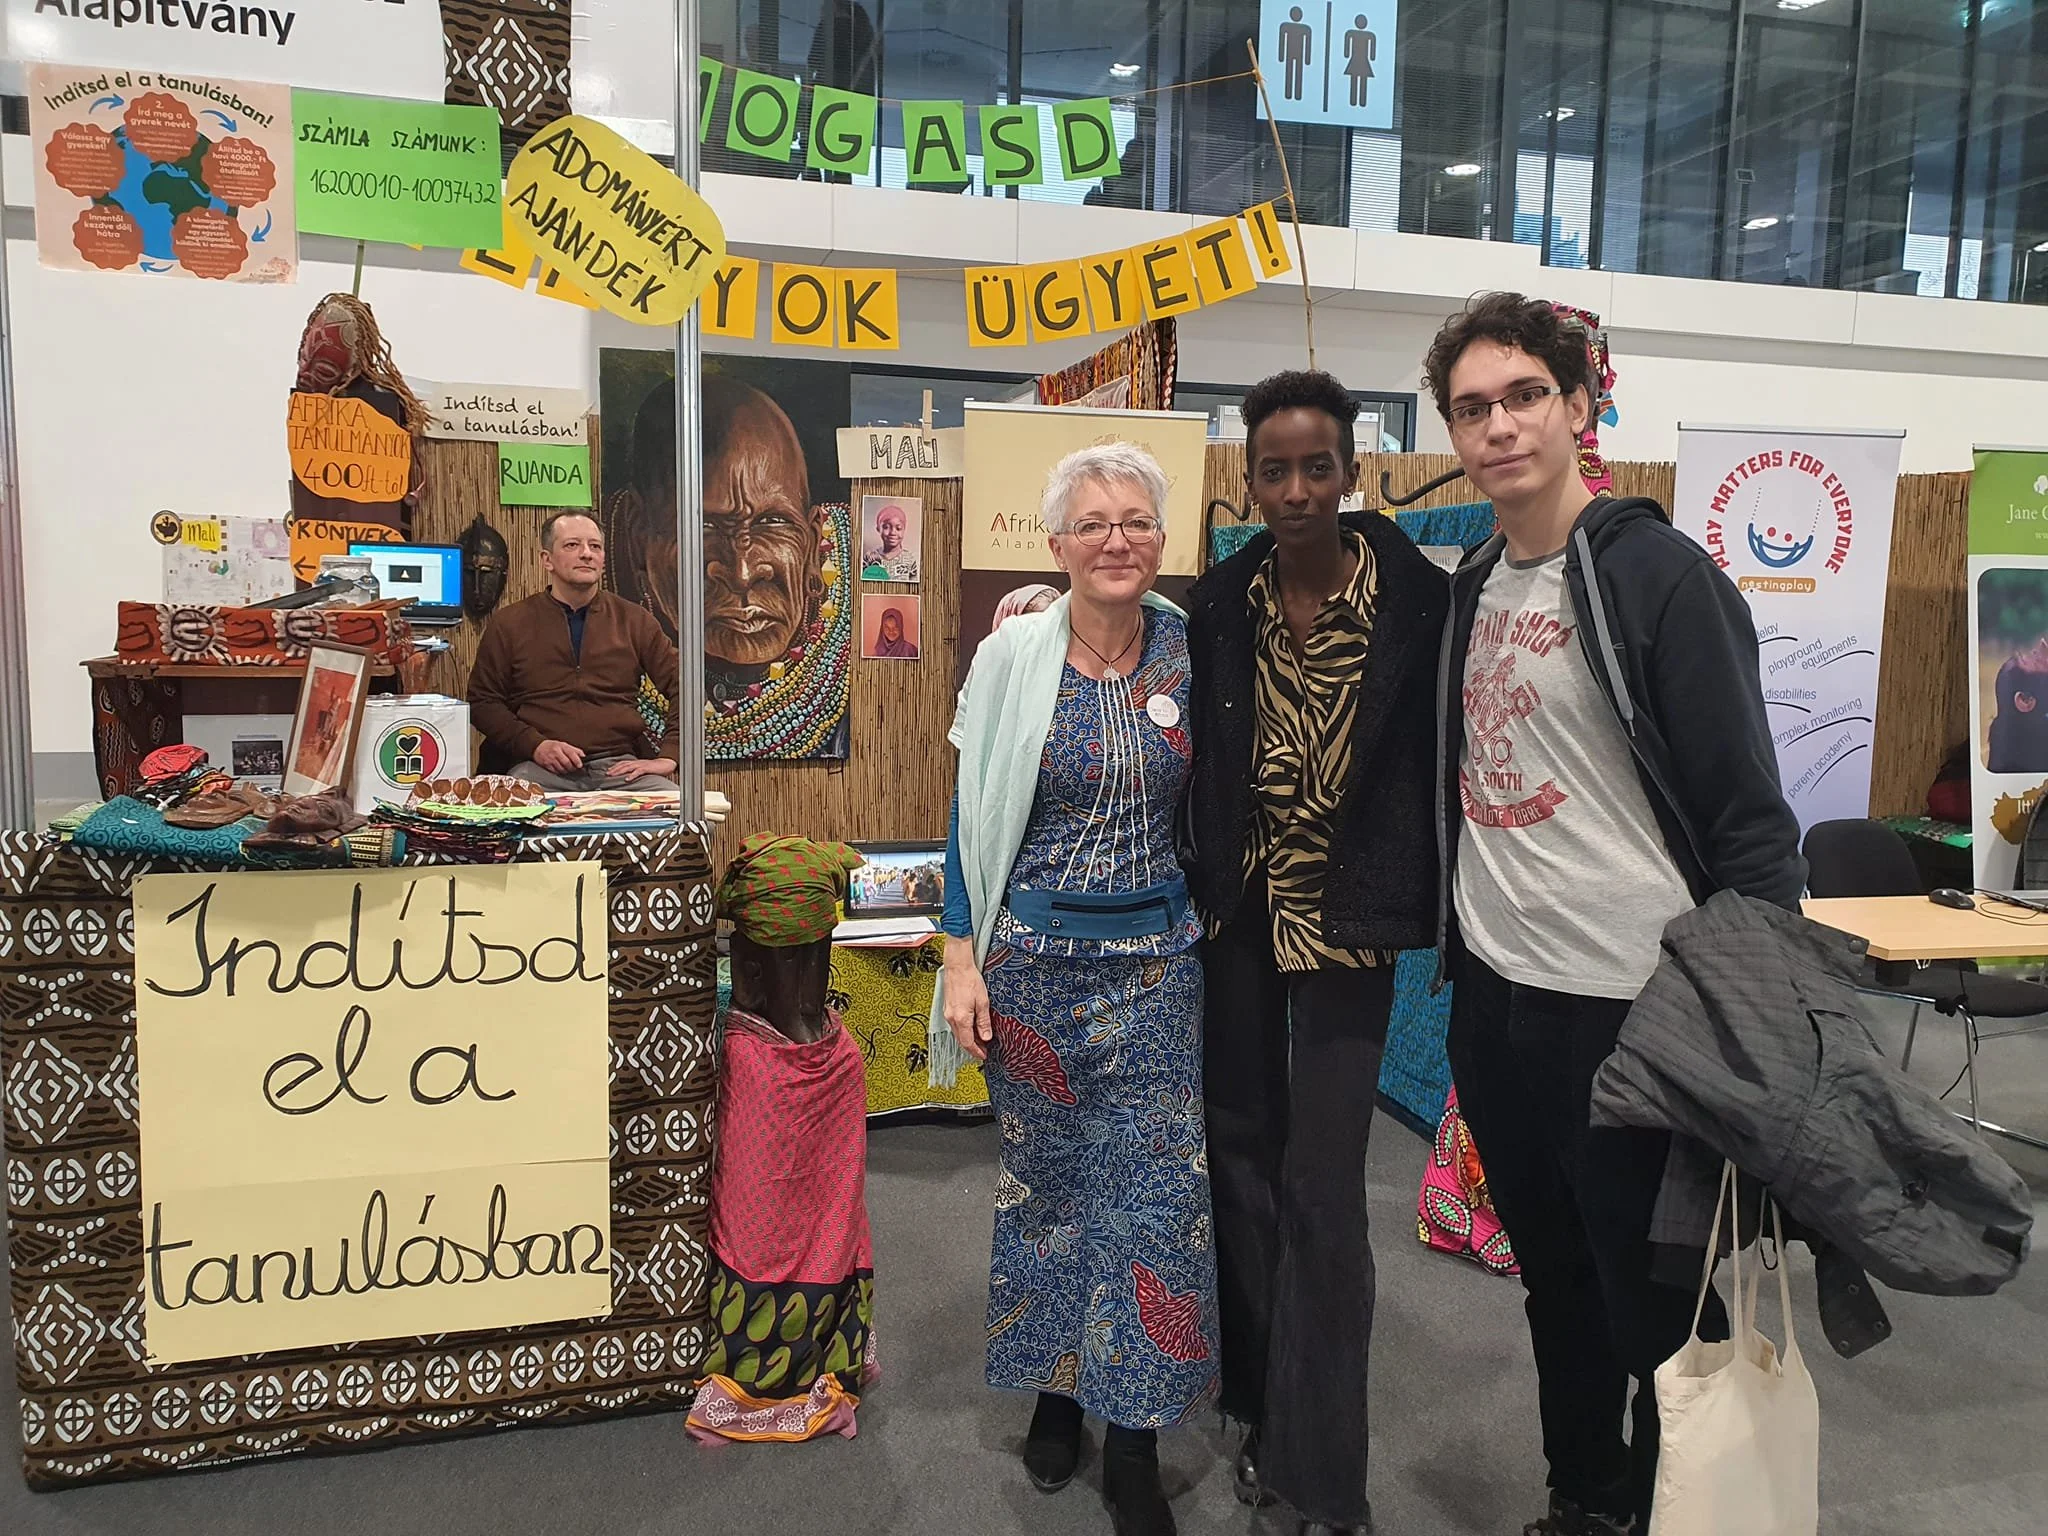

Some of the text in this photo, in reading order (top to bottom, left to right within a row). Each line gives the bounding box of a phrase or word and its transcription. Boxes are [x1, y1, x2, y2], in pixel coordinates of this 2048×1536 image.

[44, 71, 274, 128] Indítsd el a tanulásban!
[138, 105, 151, 117] Írd
[153, 110, 174, 120] meg
[130, 117, 191, 129] gyerek nevét
[299, 117, 487, 153] SZÁMLA SZÁMUNK:
[310, 169, 497, 204] 16200010-10097432
[529, 128, 713, 271] ADOMÁNYÉRT
[509, 182, 666, 314] AJÁNDÉK
[974, 210, 1280, 340] ÜGYÉT!
[289, 393, 369, 429] AFRIKA
[444, 396, 544, 415] Indítsd el
[443, 417, 579, 438] a tanulásban!
[870, 433, 940, 470] MALI
[501, 457, 583, 487] RUANDA
[990, 512, 1052, 534] Afrik
[1710, 450, 1783, 514] MATTERS
[1788, 450, 1825, 478] FOR
[1821, 472, 1853, 575] EVERYONE
[2006, 503, 2039, 524] Jane
[991, 537, 1044, 551] Alapí
[1741, 579, 1812, 592] nestingplay
[1467, 609, 1509, 656] PAIR
[1767, 637, 1823, 677] playground
[1801, 635, 1858, 670] equipments
[1764, 688, 1817, 700] disabilities
[1773, 698, 1863, 745] omplex monitoring
[1787, 731, 1853, 799] parent academy
[144, 873, 606, 998] Indítsd
[262, 1004, 517, 1117] el a
[144, 1183, 612, 1312] tanulásban
